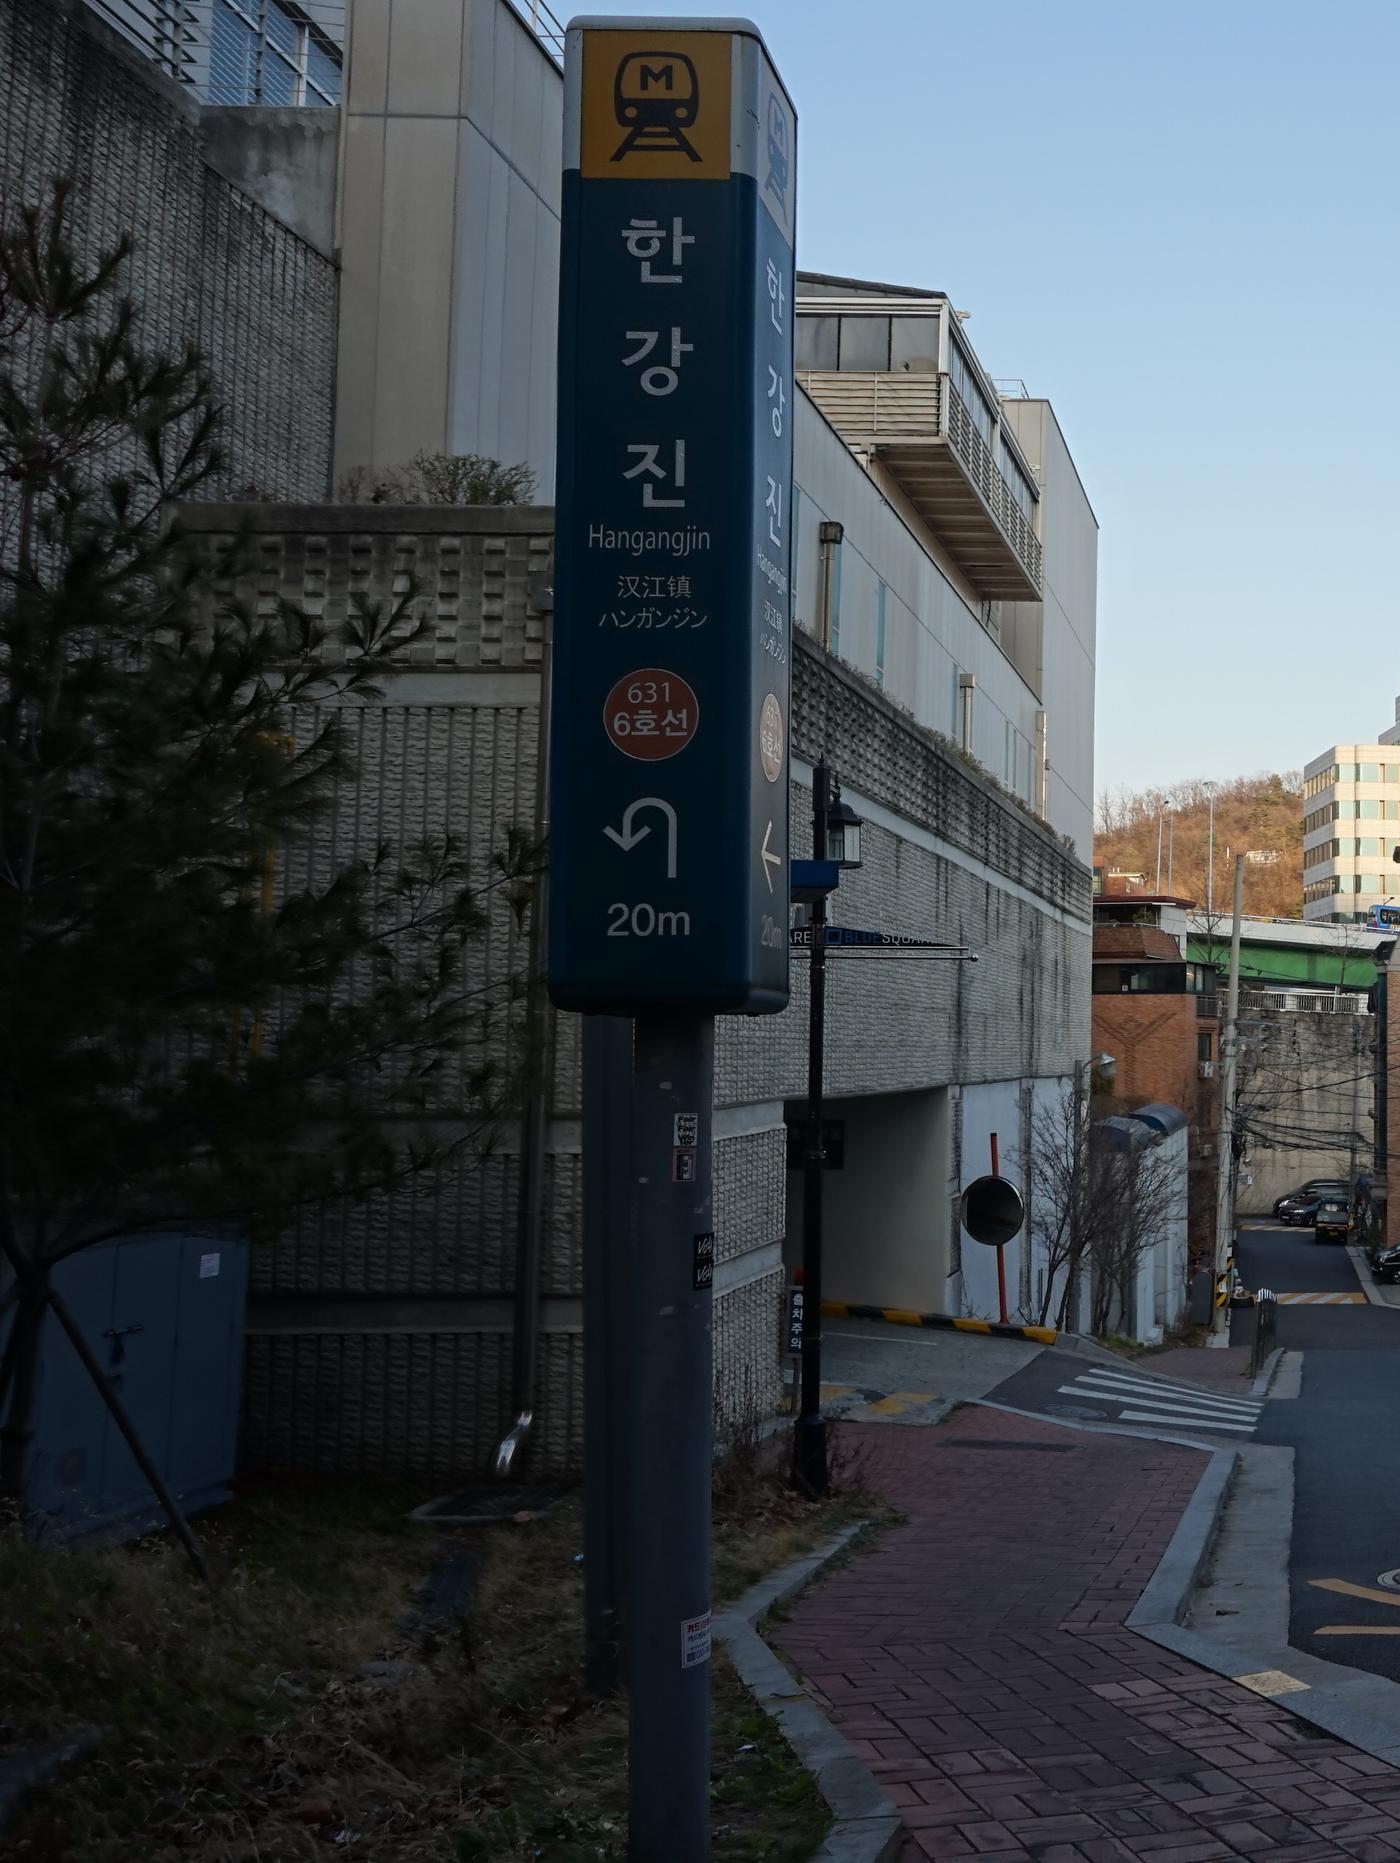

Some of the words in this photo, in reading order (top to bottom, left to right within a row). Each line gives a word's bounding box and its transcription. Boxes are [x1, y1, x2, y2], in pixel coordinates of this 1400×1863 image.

[640, 64, 673, 91] M
[621, 216, 695, 508] 한강진
[589, 523, 710, 556] Hangangjin
[617, 575, 692, 598] 汉江镇
[598, 606, 708, 629] ハンガンジン
[627, 682, 671, 704] 631
[613, 708, 688, 737] 6호선
[606, 902, 691, 937] 20m
